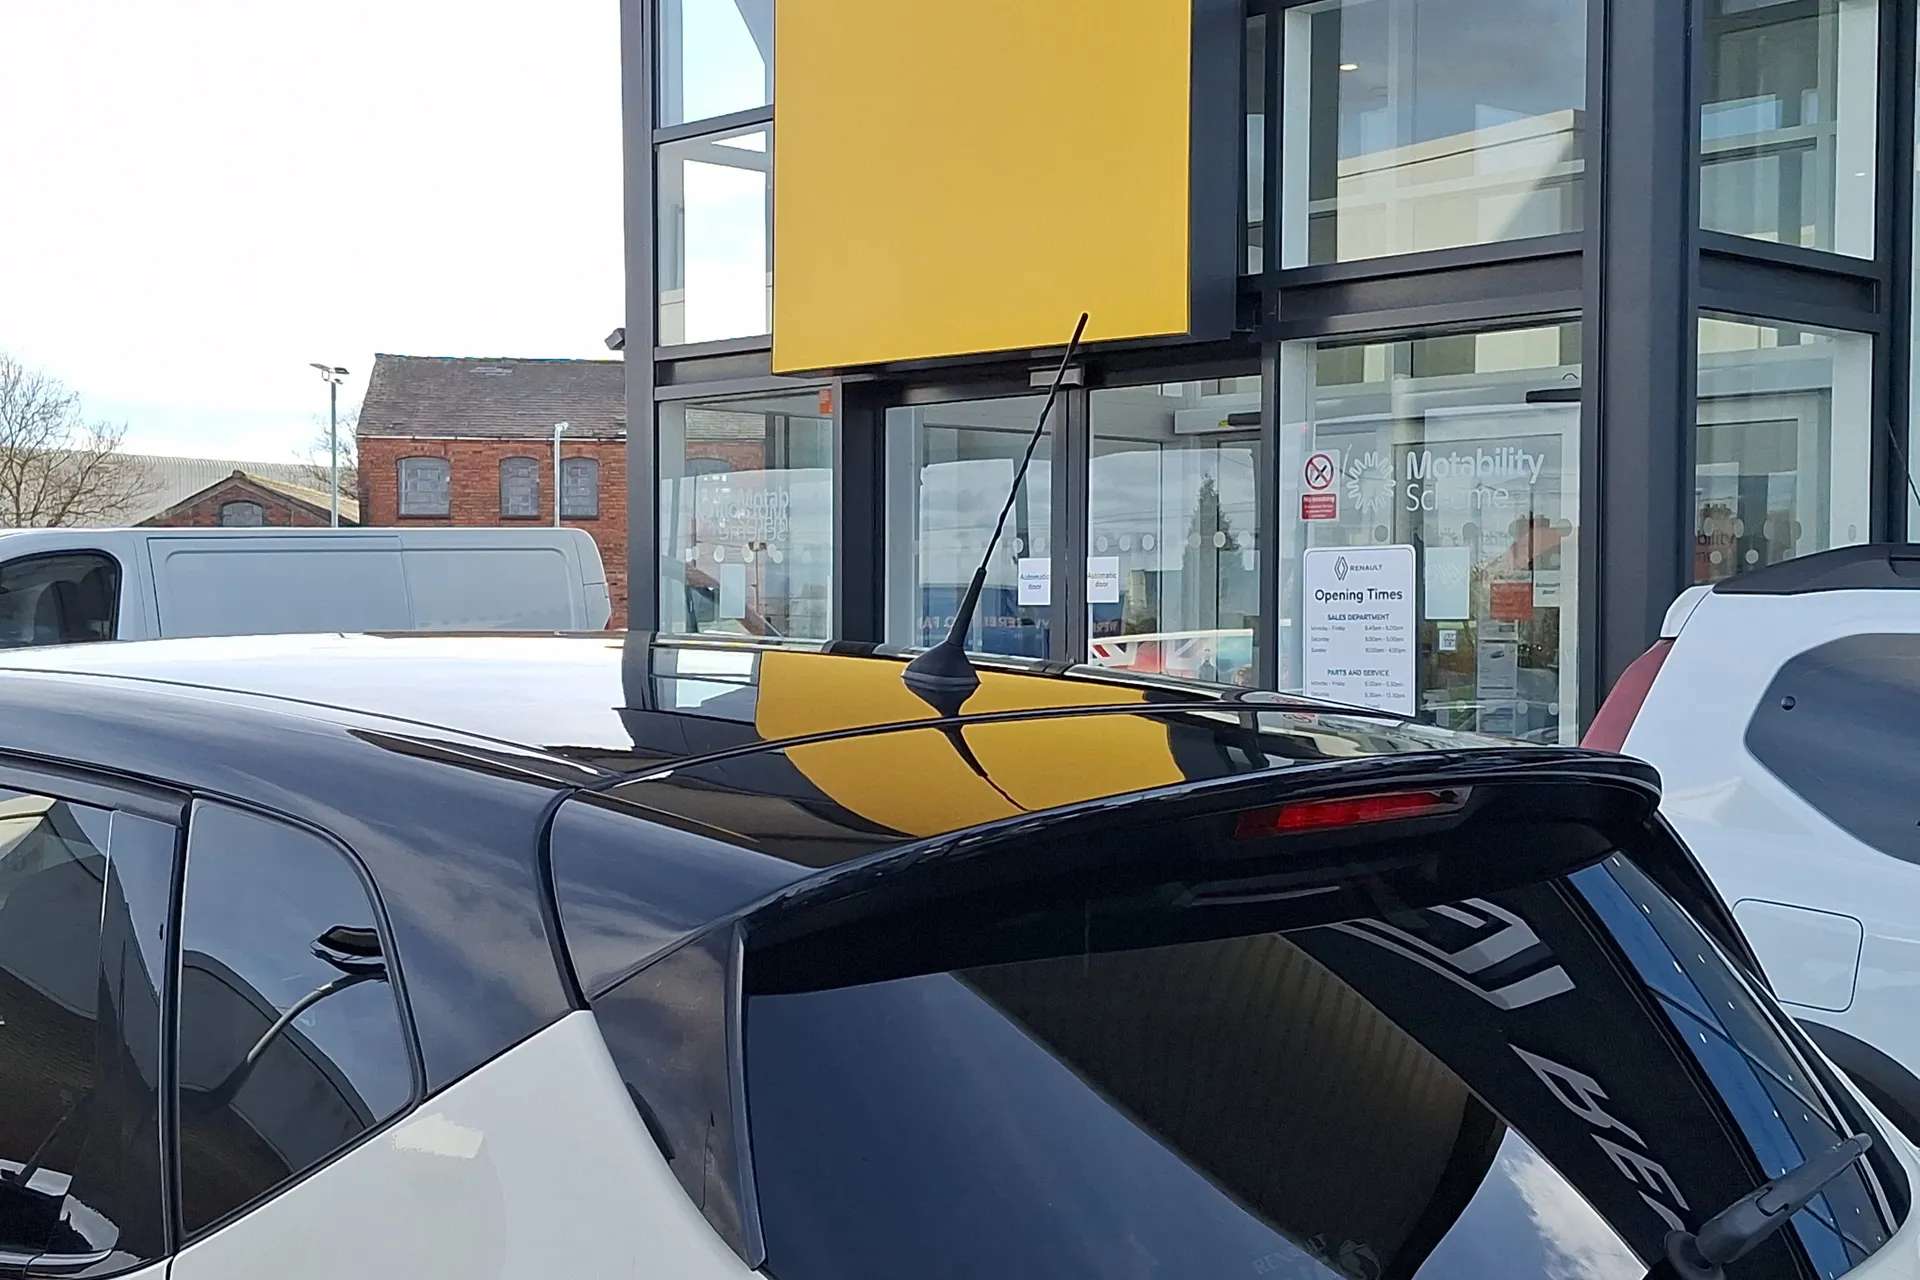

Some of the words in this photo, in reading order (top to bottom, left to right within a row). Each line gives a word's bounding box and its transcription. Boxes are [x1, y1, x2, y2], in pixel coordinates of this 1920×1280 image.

[1406, 447, 1545, 484] Motability
[1315, 589, 1364, 604] Opening
[1367, 588, 1403, 600] Times
